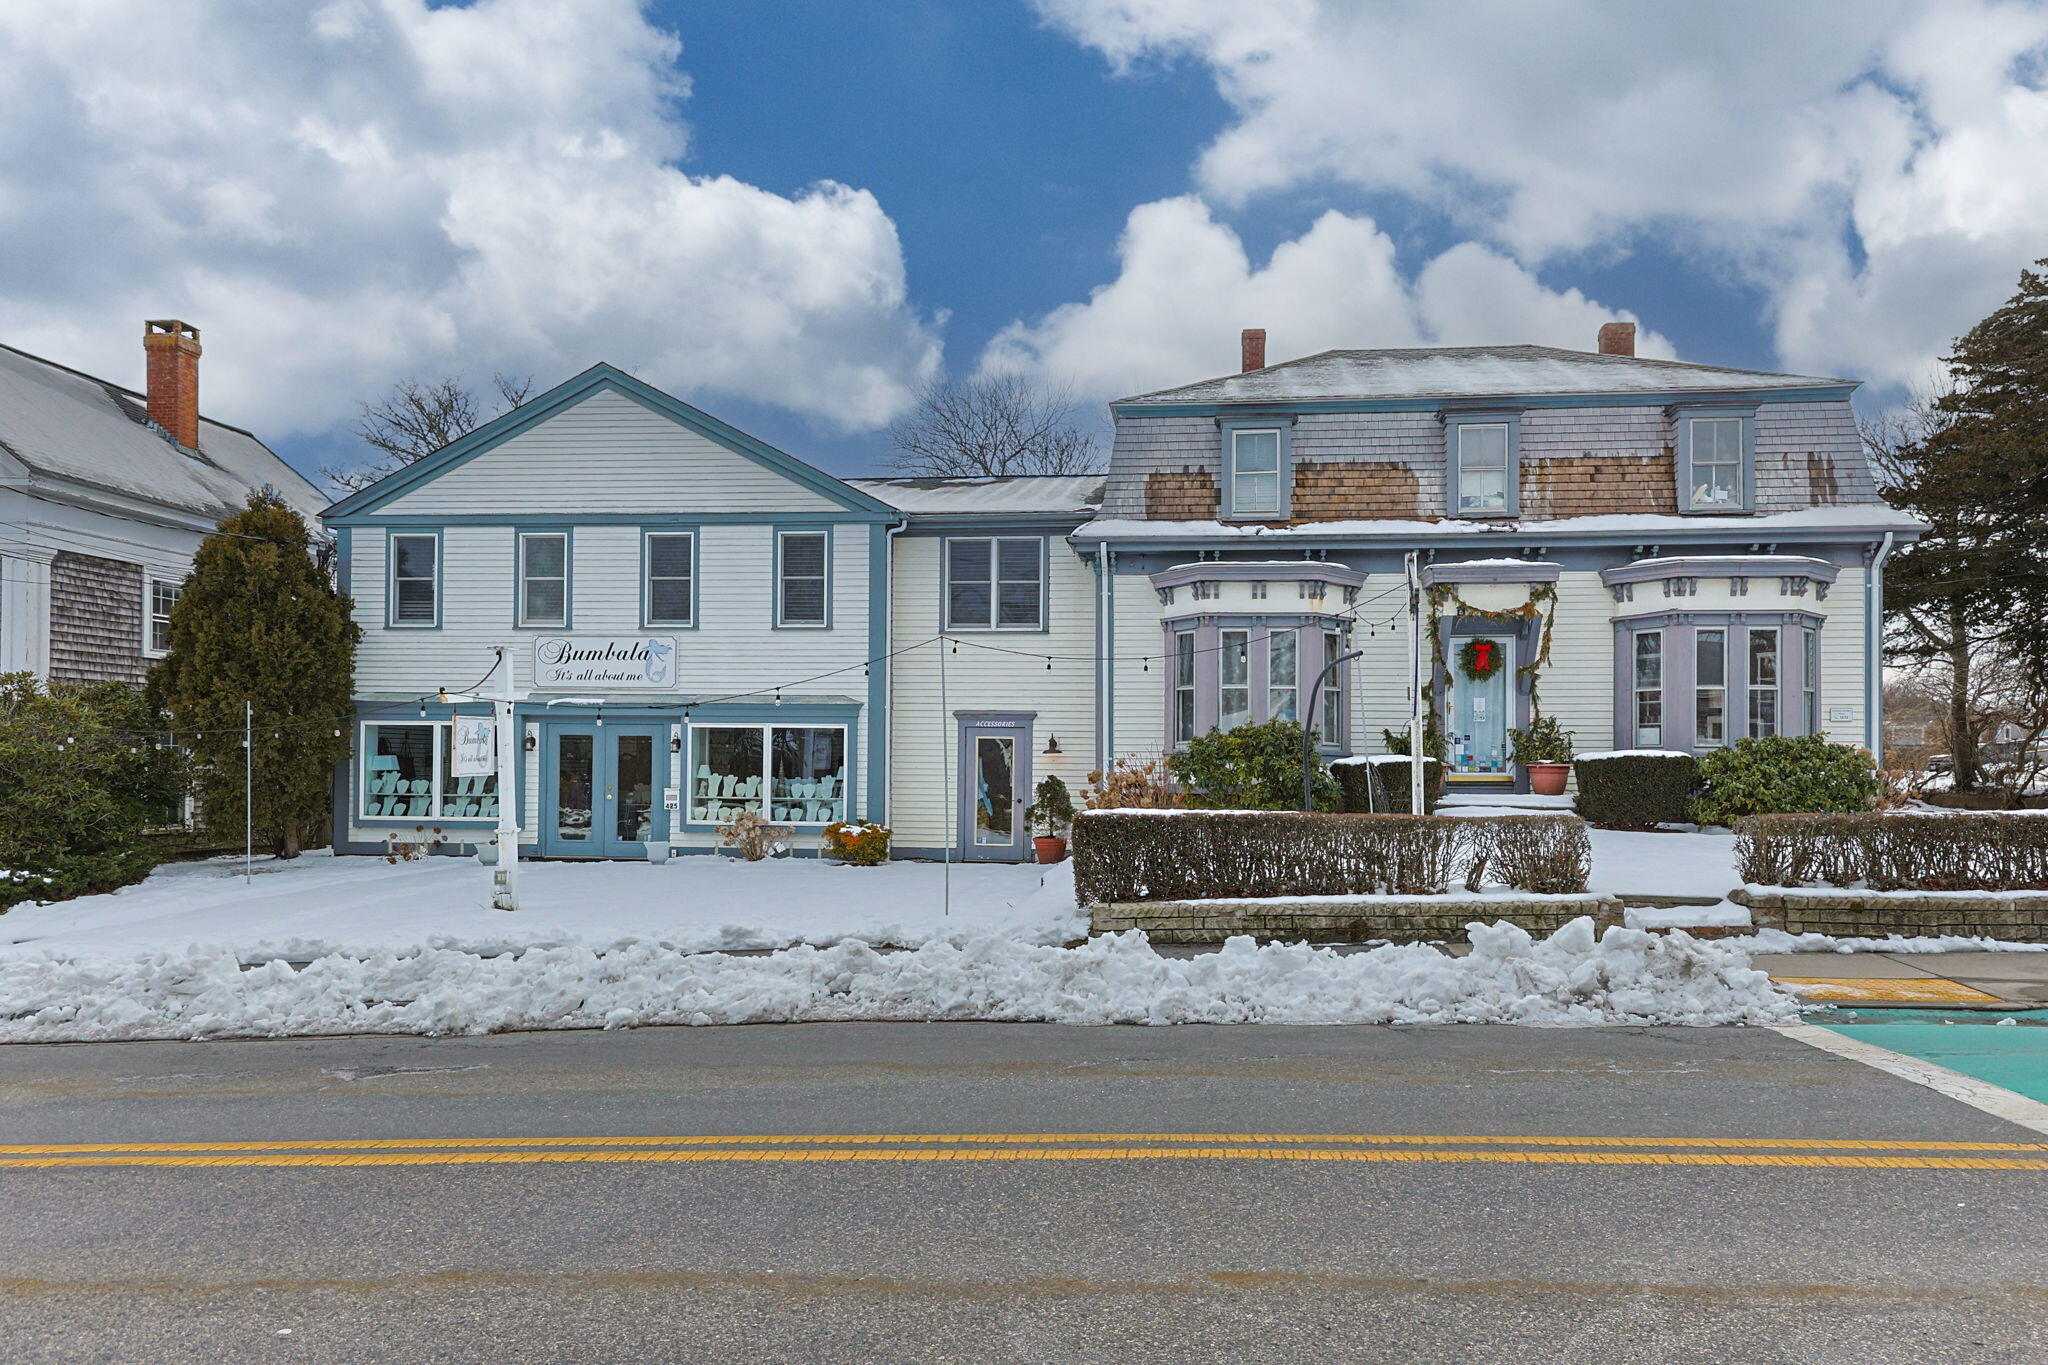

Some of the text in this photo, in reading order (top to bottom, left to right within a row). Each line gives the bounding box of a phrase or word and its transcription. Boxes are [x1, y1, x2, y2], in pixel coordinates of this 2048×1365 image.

[538, 639, 650, 665] Bumbala
[545, 668, 643, 681] It's all about me
